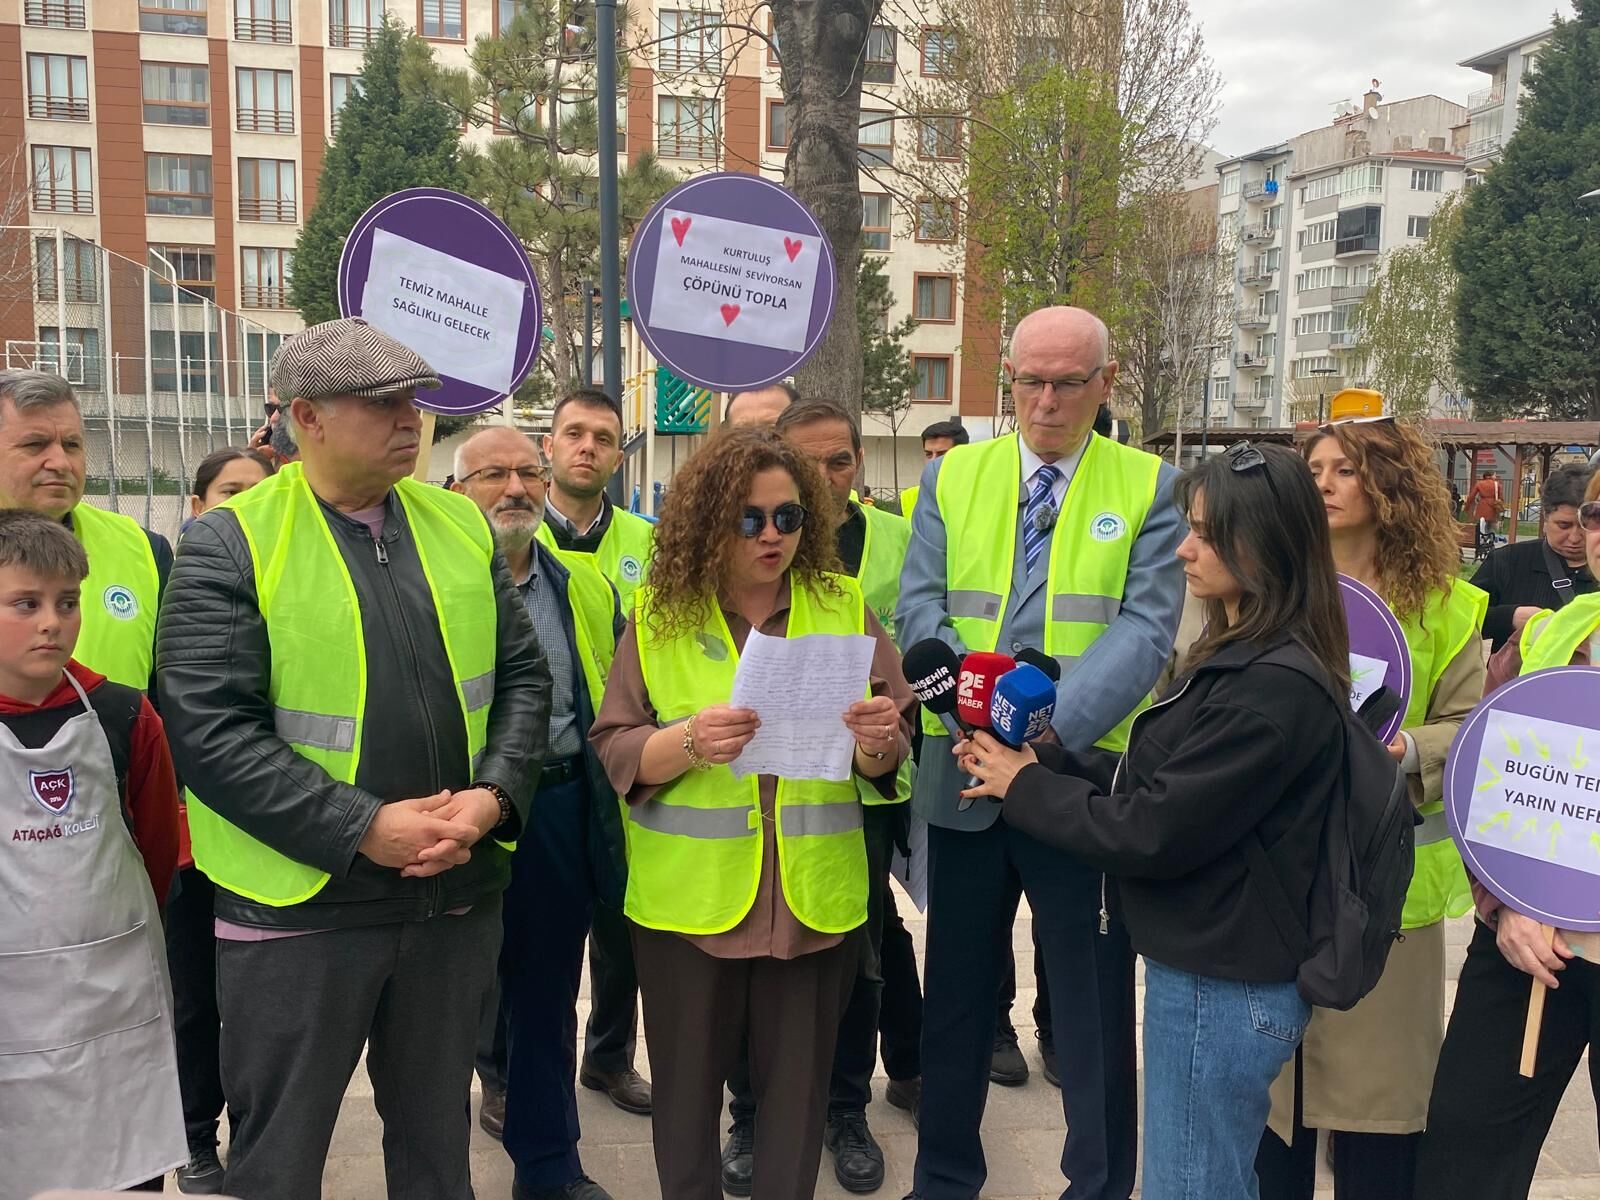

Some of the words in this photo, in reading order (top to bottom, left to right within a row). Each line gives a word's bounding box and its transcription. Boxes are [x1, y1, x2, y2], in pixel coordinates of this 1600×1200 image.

[723, 247, 771, 266] KURTULUŞ
[680, 256, 742, 276] MAHALLESİNİ
[745, 270, 803, 289] SEVİYORSAN
[399, 276, 434, 298] TEMİZ
[436, 290, 489, 318] MAHALLE
[683, 276, 742, 299] ÇÖPÜNÜ
[745, 289, 788, 310] TOPLA
[392, 297, 441, 324] SAĞLIKLI
[444, 316, 491, 340] GELECEK
[958, 670, 986, 698] 2E
[957, 696, 984, 710] HABER
[994, 690, 1017, 715] NET
[1028, 703, 1054, 721] NET
[991, 705, 1012, 732] 26
[40, 778, 67, 791] AÇK
[1504, 759, 1569, 785] BUGÜN
[1504, 788, 1556, 813] YARIN
[12, 824, 62, 843] ATAÇAĞ
[64, 814, 100, 837] KOLEJİ
